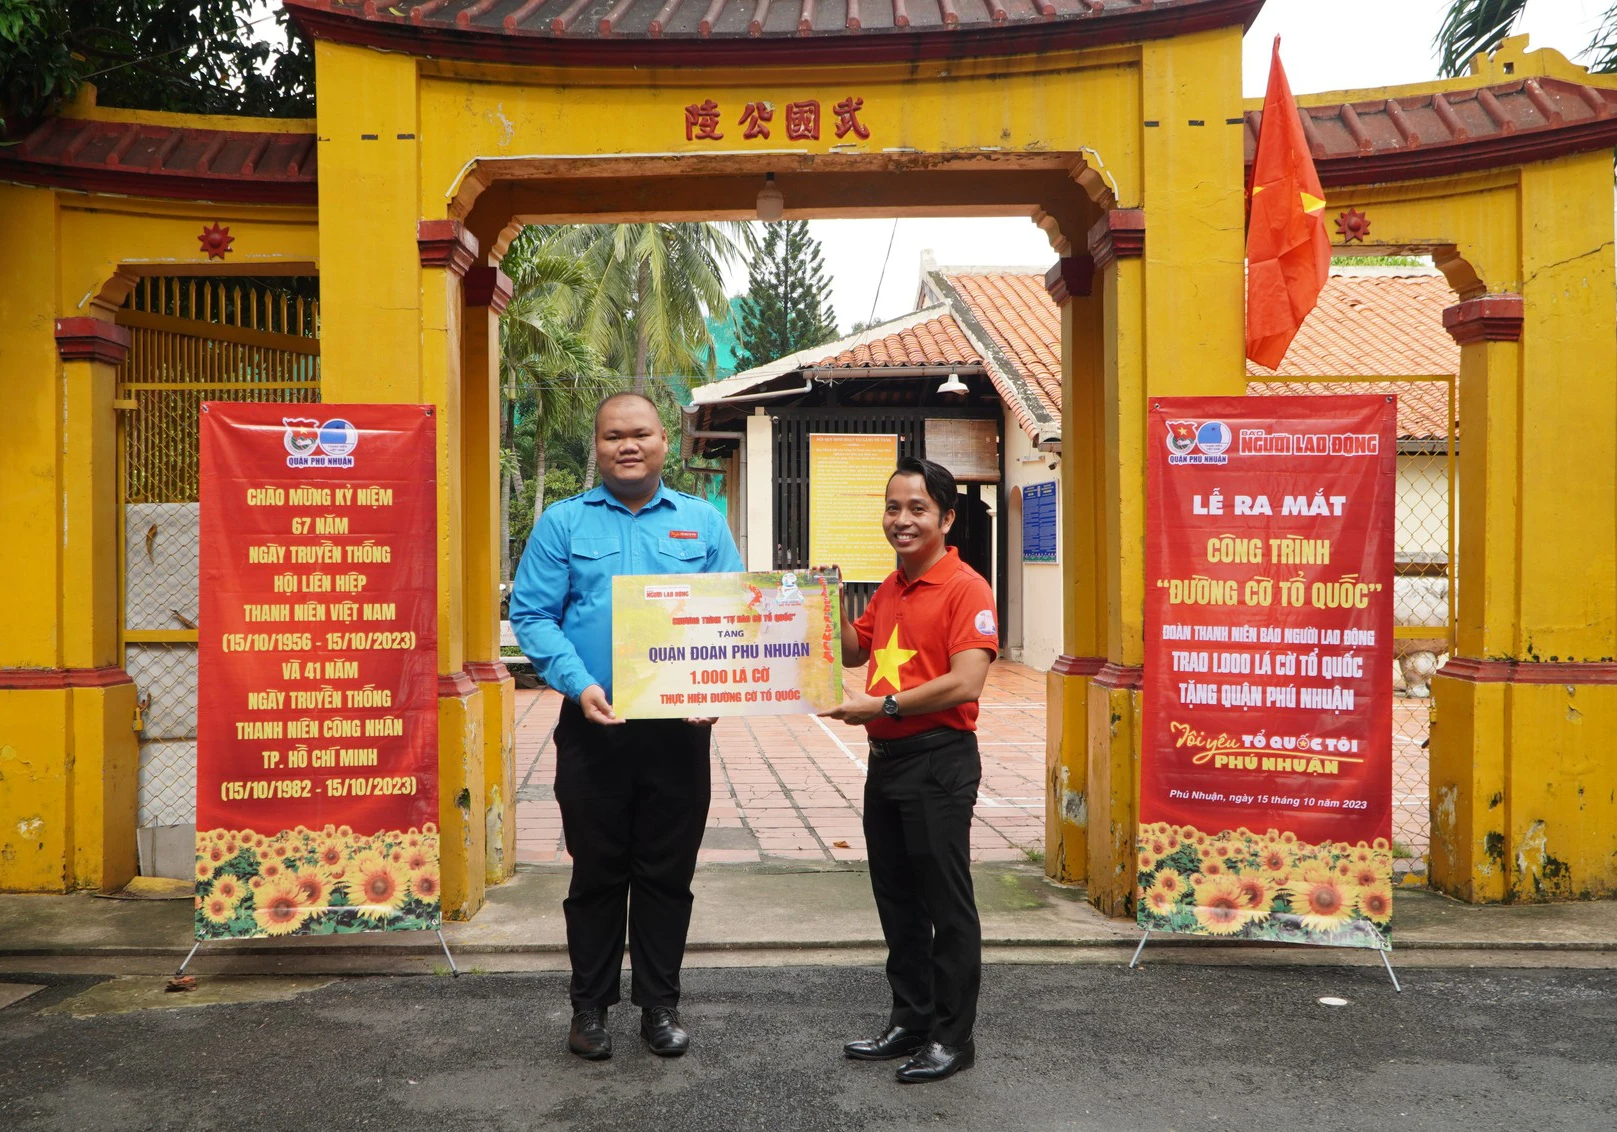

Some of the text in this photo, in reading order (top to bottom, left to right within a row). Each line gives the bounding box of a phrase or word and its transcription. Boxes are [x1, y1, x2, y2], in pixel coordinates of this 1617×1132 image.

[1294, 435, 1328, 455] LAO
[1330, 433, 1378, 456] ĐỘNG
[247, 484, 393, 508] CHÀO MỪNG KỶ NIỆM
[1193, 488, 1346, 516] LỄ RA MẮT
[292, 514, 348, 534] 67 NĂM
[249, 540, 390, 563] NGÀY TRUYỀN THỐNG
[1207, 534, 1330, 565] CÔNG TRÌNH
[274, 572, 366, 595] HỘI LIÊN HIỆP
[1245, 576, 1273, 606] CỜ
[1279, 571, 1306, 607] TỔ
[244, 601, 396, 624] THANH NIÊN VIỆT NAM
[223, 634, 311, 652] (15/10/1956
[326, 632, 415, 650] 15/10/2023)
[1163, 623, 1375, 649] ĐOÀN THANH NIÊN BÁO NGƯỜI LAO ĐỘNG
[648, 645, 685, 664] QUẬN
[732, 642, 759, 659] PHÚ
[764, 641, 809, 660] NHUẬN
[1172, 651, 1208, 673] TRAO
[1255, 651, 1271, 675] LÁ
[1276, 651, 1296, 676] CỜ
[1299, 648, 1319, 677] TỔ
[1322, 651, 1363, 679] QUỐC
[282, 659, 358, 680] VÀ 41 NĂM
[690, 666, 770, 684] 1.000 LÁ CỜ
[248, 684, 391, 710] NGÀY TRUYỀN THỐNG
[660, 694, 684, 706] THỰC
[687, 692, 707, 705] HIỆN
[710, 692, 742, 703] ĐƯỜNG
[745, 690, 757, 702] CỜ
[775, 688, 801, 701] QUỐC
[1179, 680, 1354, 714] TẶNG QUẬN PHÚ NHUẬN
[236, 716, 402, 739] THANH NIÊN CÔNG NHÂN
[1242, 730, 1266, 748] TỔ
[1325, 738, 1358, 752] TÔI
[262, 745, 377, 768] TP. HỒ CHÍ MINH
[1215, 753, 1338, 776] PHÚ NHUẬN
[221, 779, 311, 801] (15/10/1982
[326, 776, 416, 796] 15/10/2023)
[1170, 789, 1368, 809] Phú Nhuận, ngày 15 tháng 10 năm 2023
